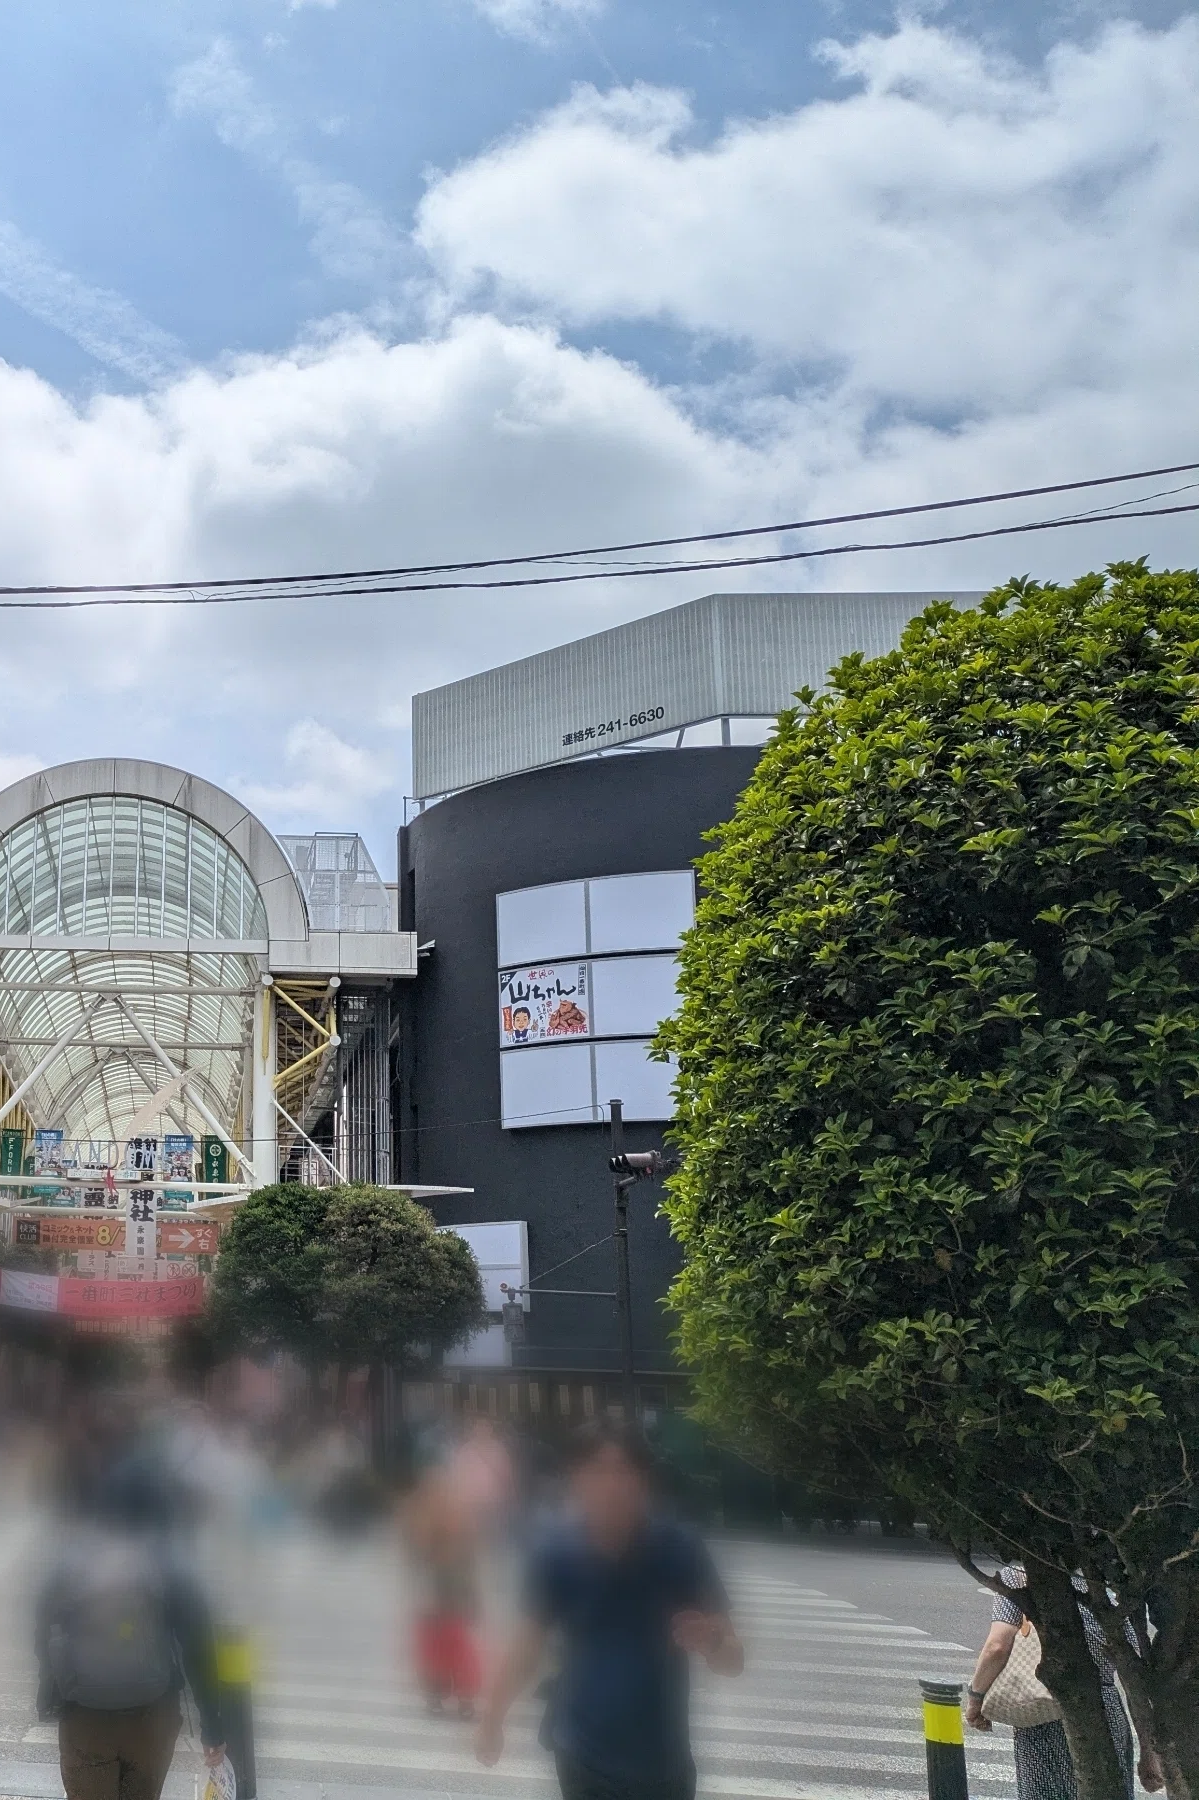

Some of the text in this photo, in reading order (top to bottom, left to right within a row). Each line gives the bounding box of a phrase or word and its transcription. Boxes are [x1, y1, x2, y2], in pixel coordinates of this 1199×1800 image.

[562, 706, 665, 746] 連絡先 241-6630
[502, 974, 511, 983] 2F
[508, 978, 577, 1005] 山ちゃん
[19, 1233, 37, 1241] CLUB
[195, 1228, 213, 1238] すぐ
[198, 1239, 209, 1250] 右
[65, 1282, 198, 1303] 一番町三社まつり
